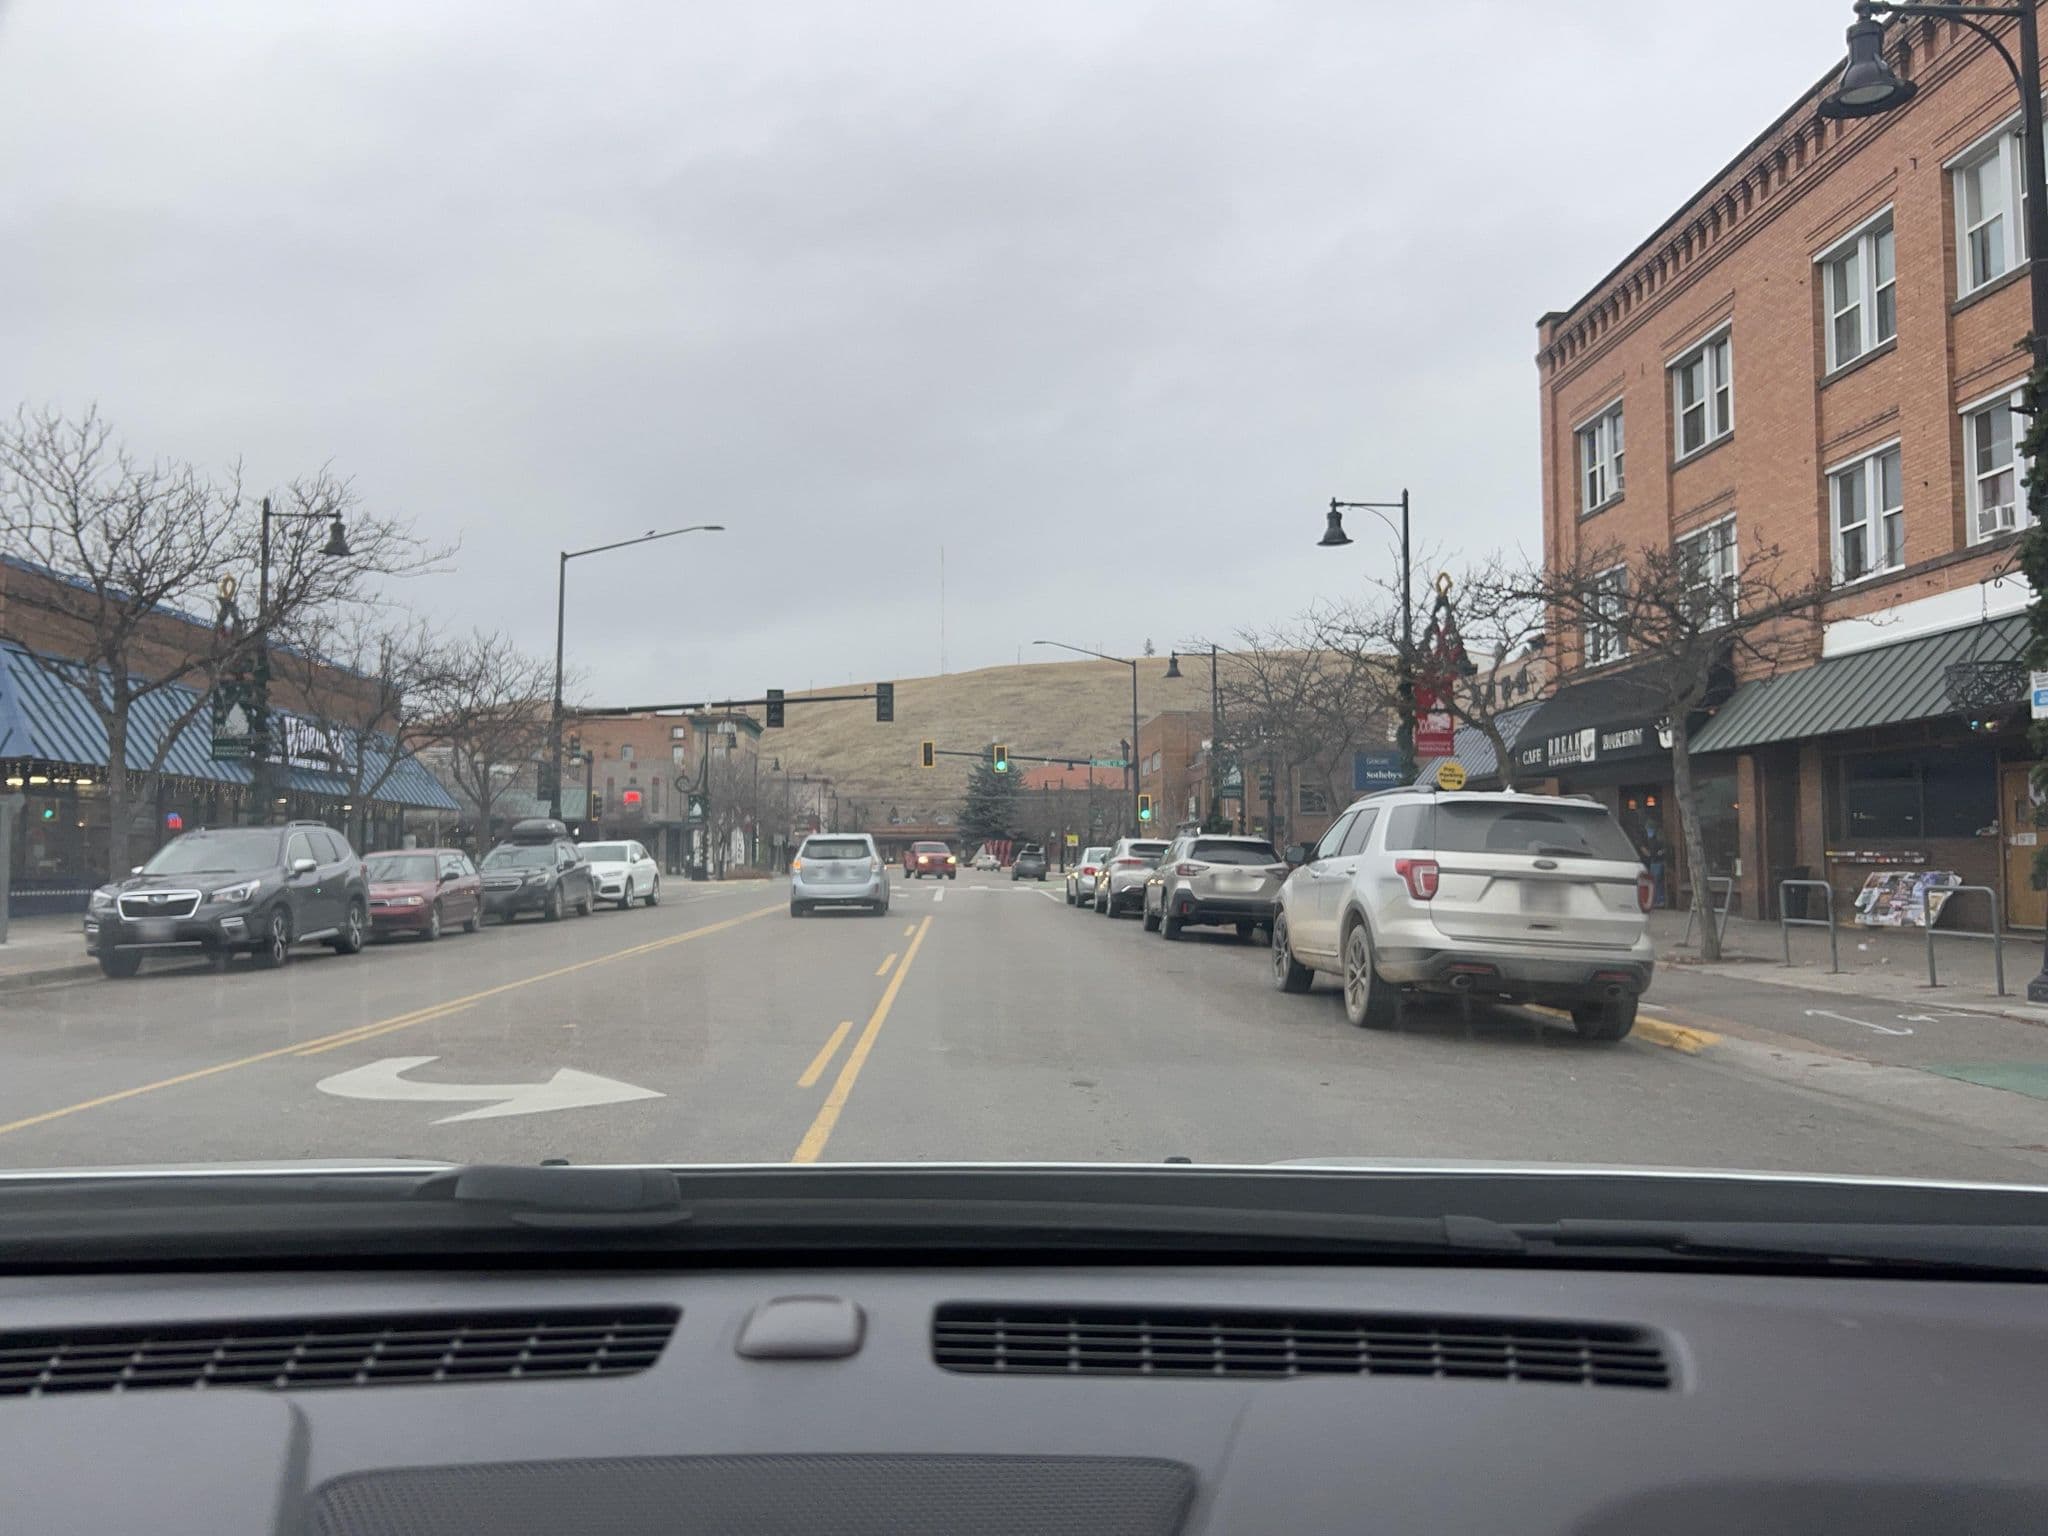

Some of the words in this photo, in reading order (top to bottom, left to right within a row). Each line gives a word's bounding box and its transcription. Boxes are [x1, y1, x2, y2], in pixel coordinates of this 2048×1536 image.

[1548, 732, 1580, 755] BREAK
[1602, 727, 1643, 750] BAKERY
[1522, 748, 1542, 765] CAFE
